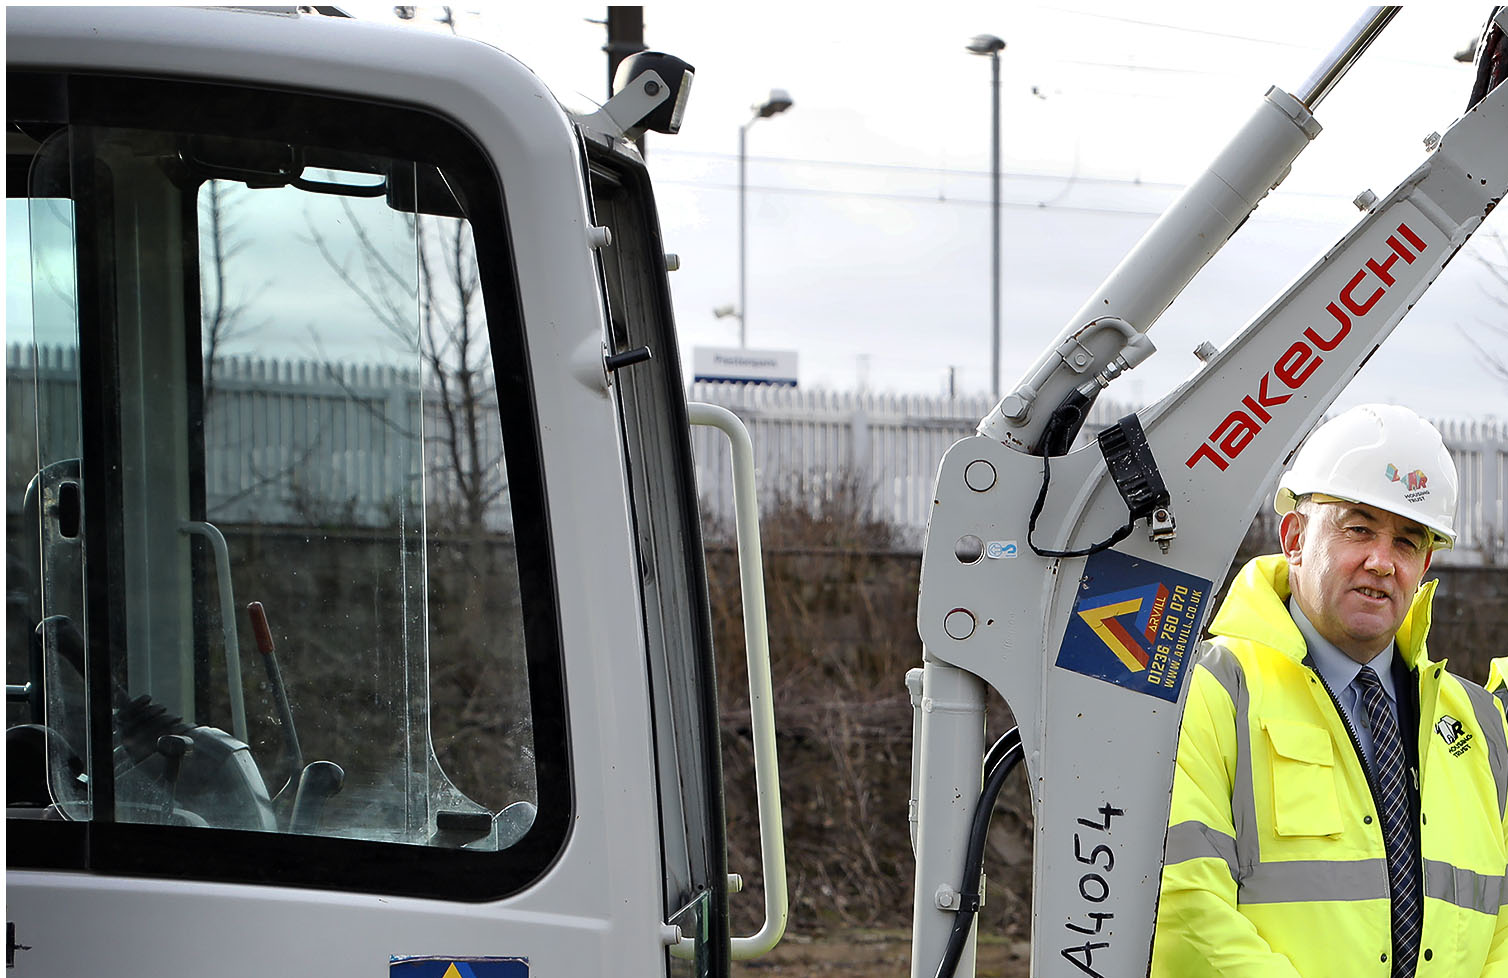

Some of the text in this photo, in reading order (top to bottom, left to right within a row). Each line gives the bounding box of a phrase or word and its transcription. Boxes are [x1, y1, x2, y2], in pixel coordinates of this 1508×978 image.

[1147, 584, 1189, 685] 01236 760 070
[1148, 596, 1167, 633] ARVILL
[1164, 589, 1203, 689] WWW.ARVILL.CO.UK
